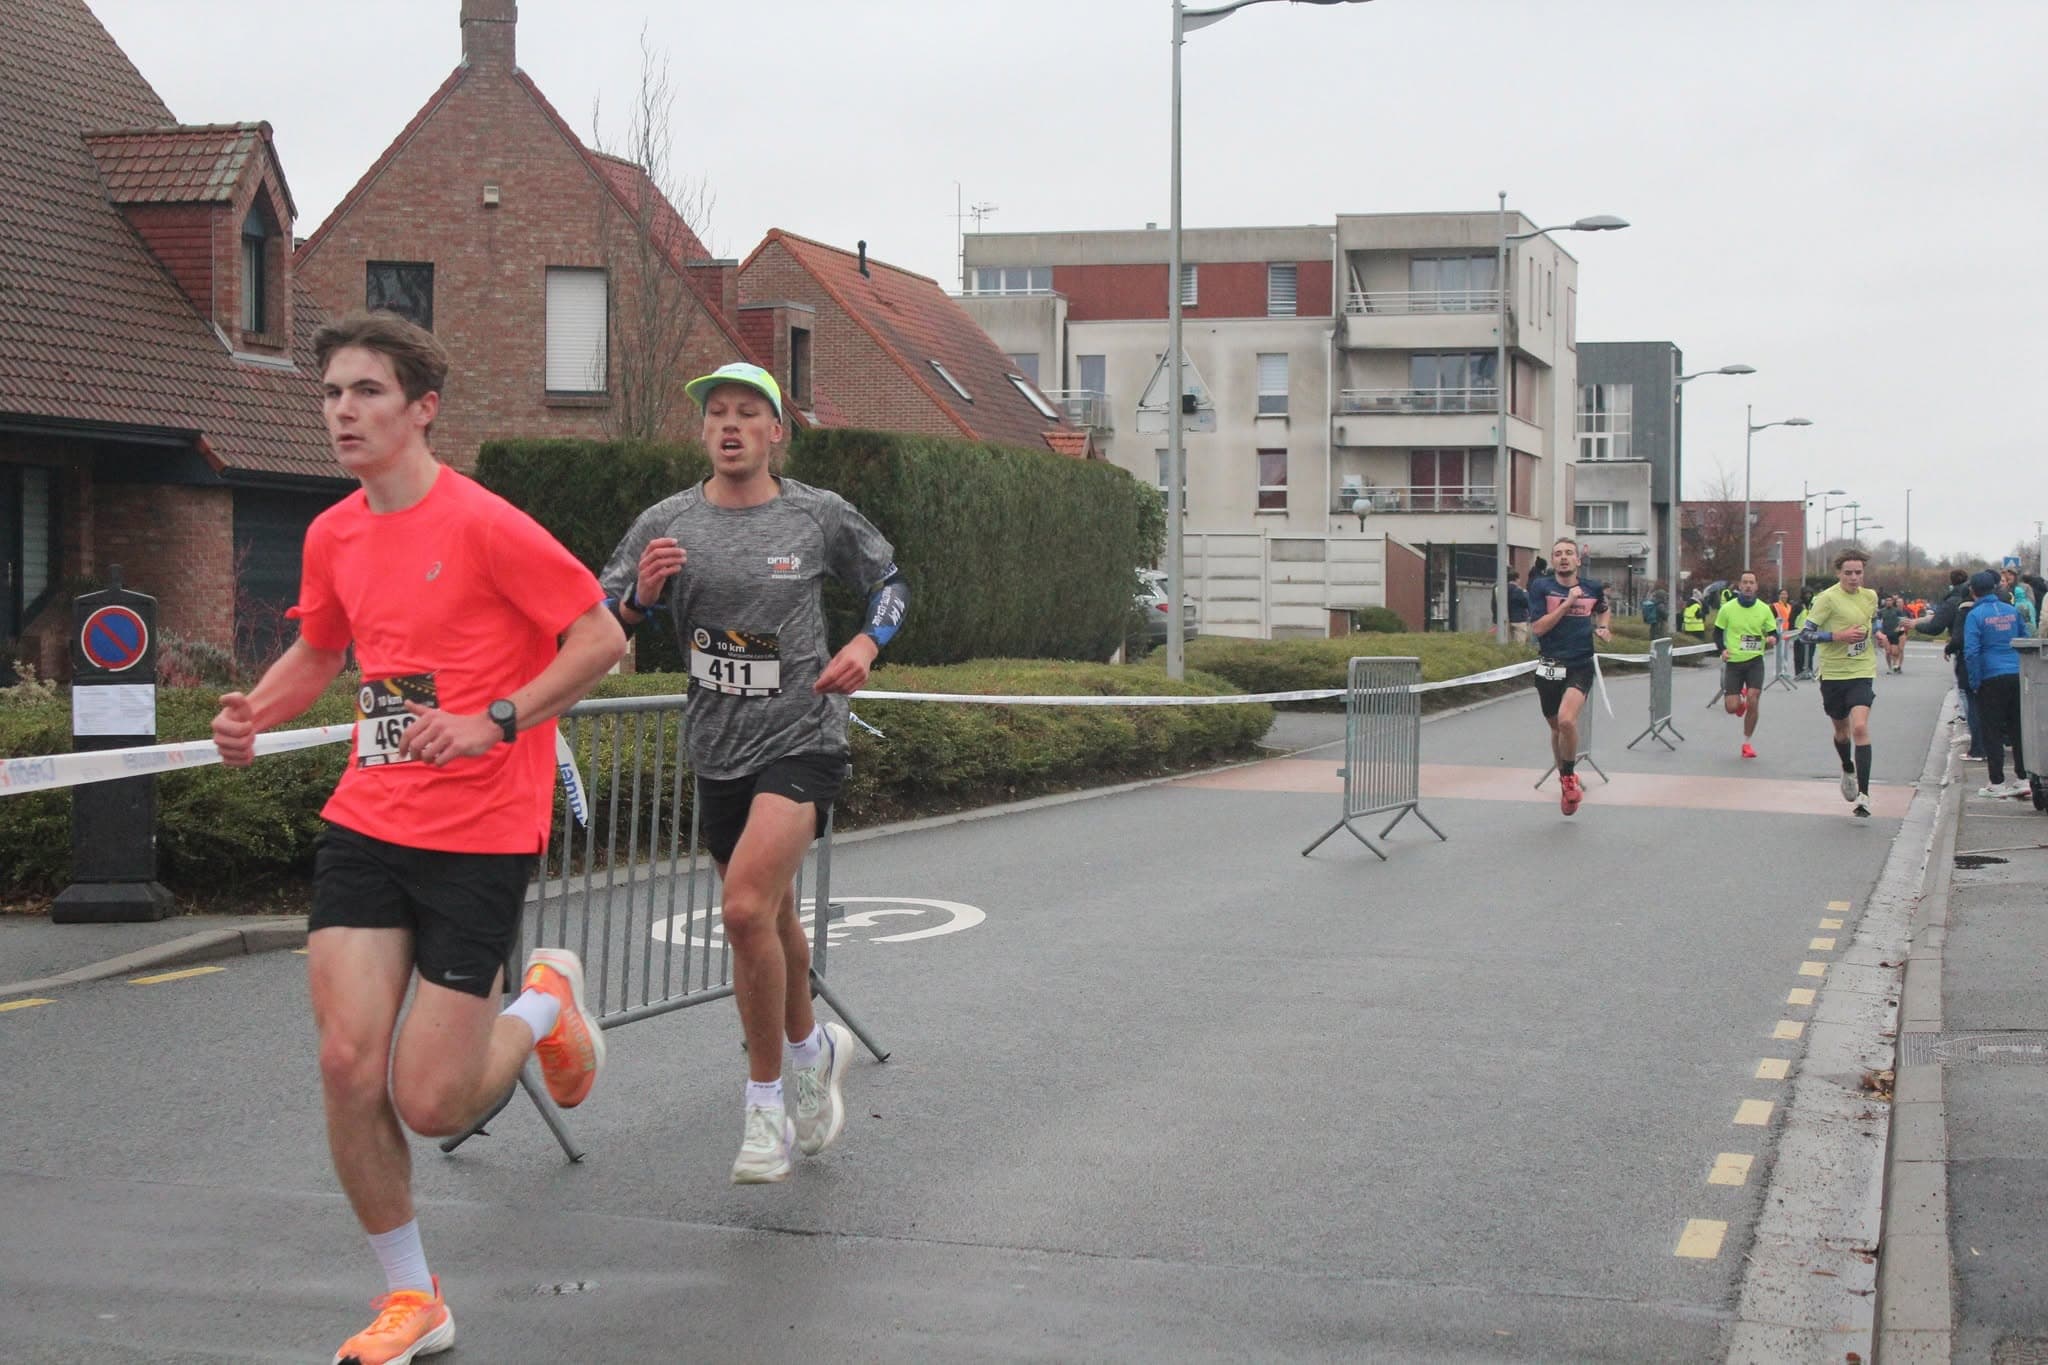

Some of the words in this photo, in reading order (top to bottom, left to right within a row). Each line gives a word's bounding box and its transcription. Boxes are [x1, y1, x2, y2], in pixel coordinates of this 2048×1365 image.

[716, 641, 728, 651] 10
[729, 643, 745, 653] km
[708, 659, 751, 686] 411
